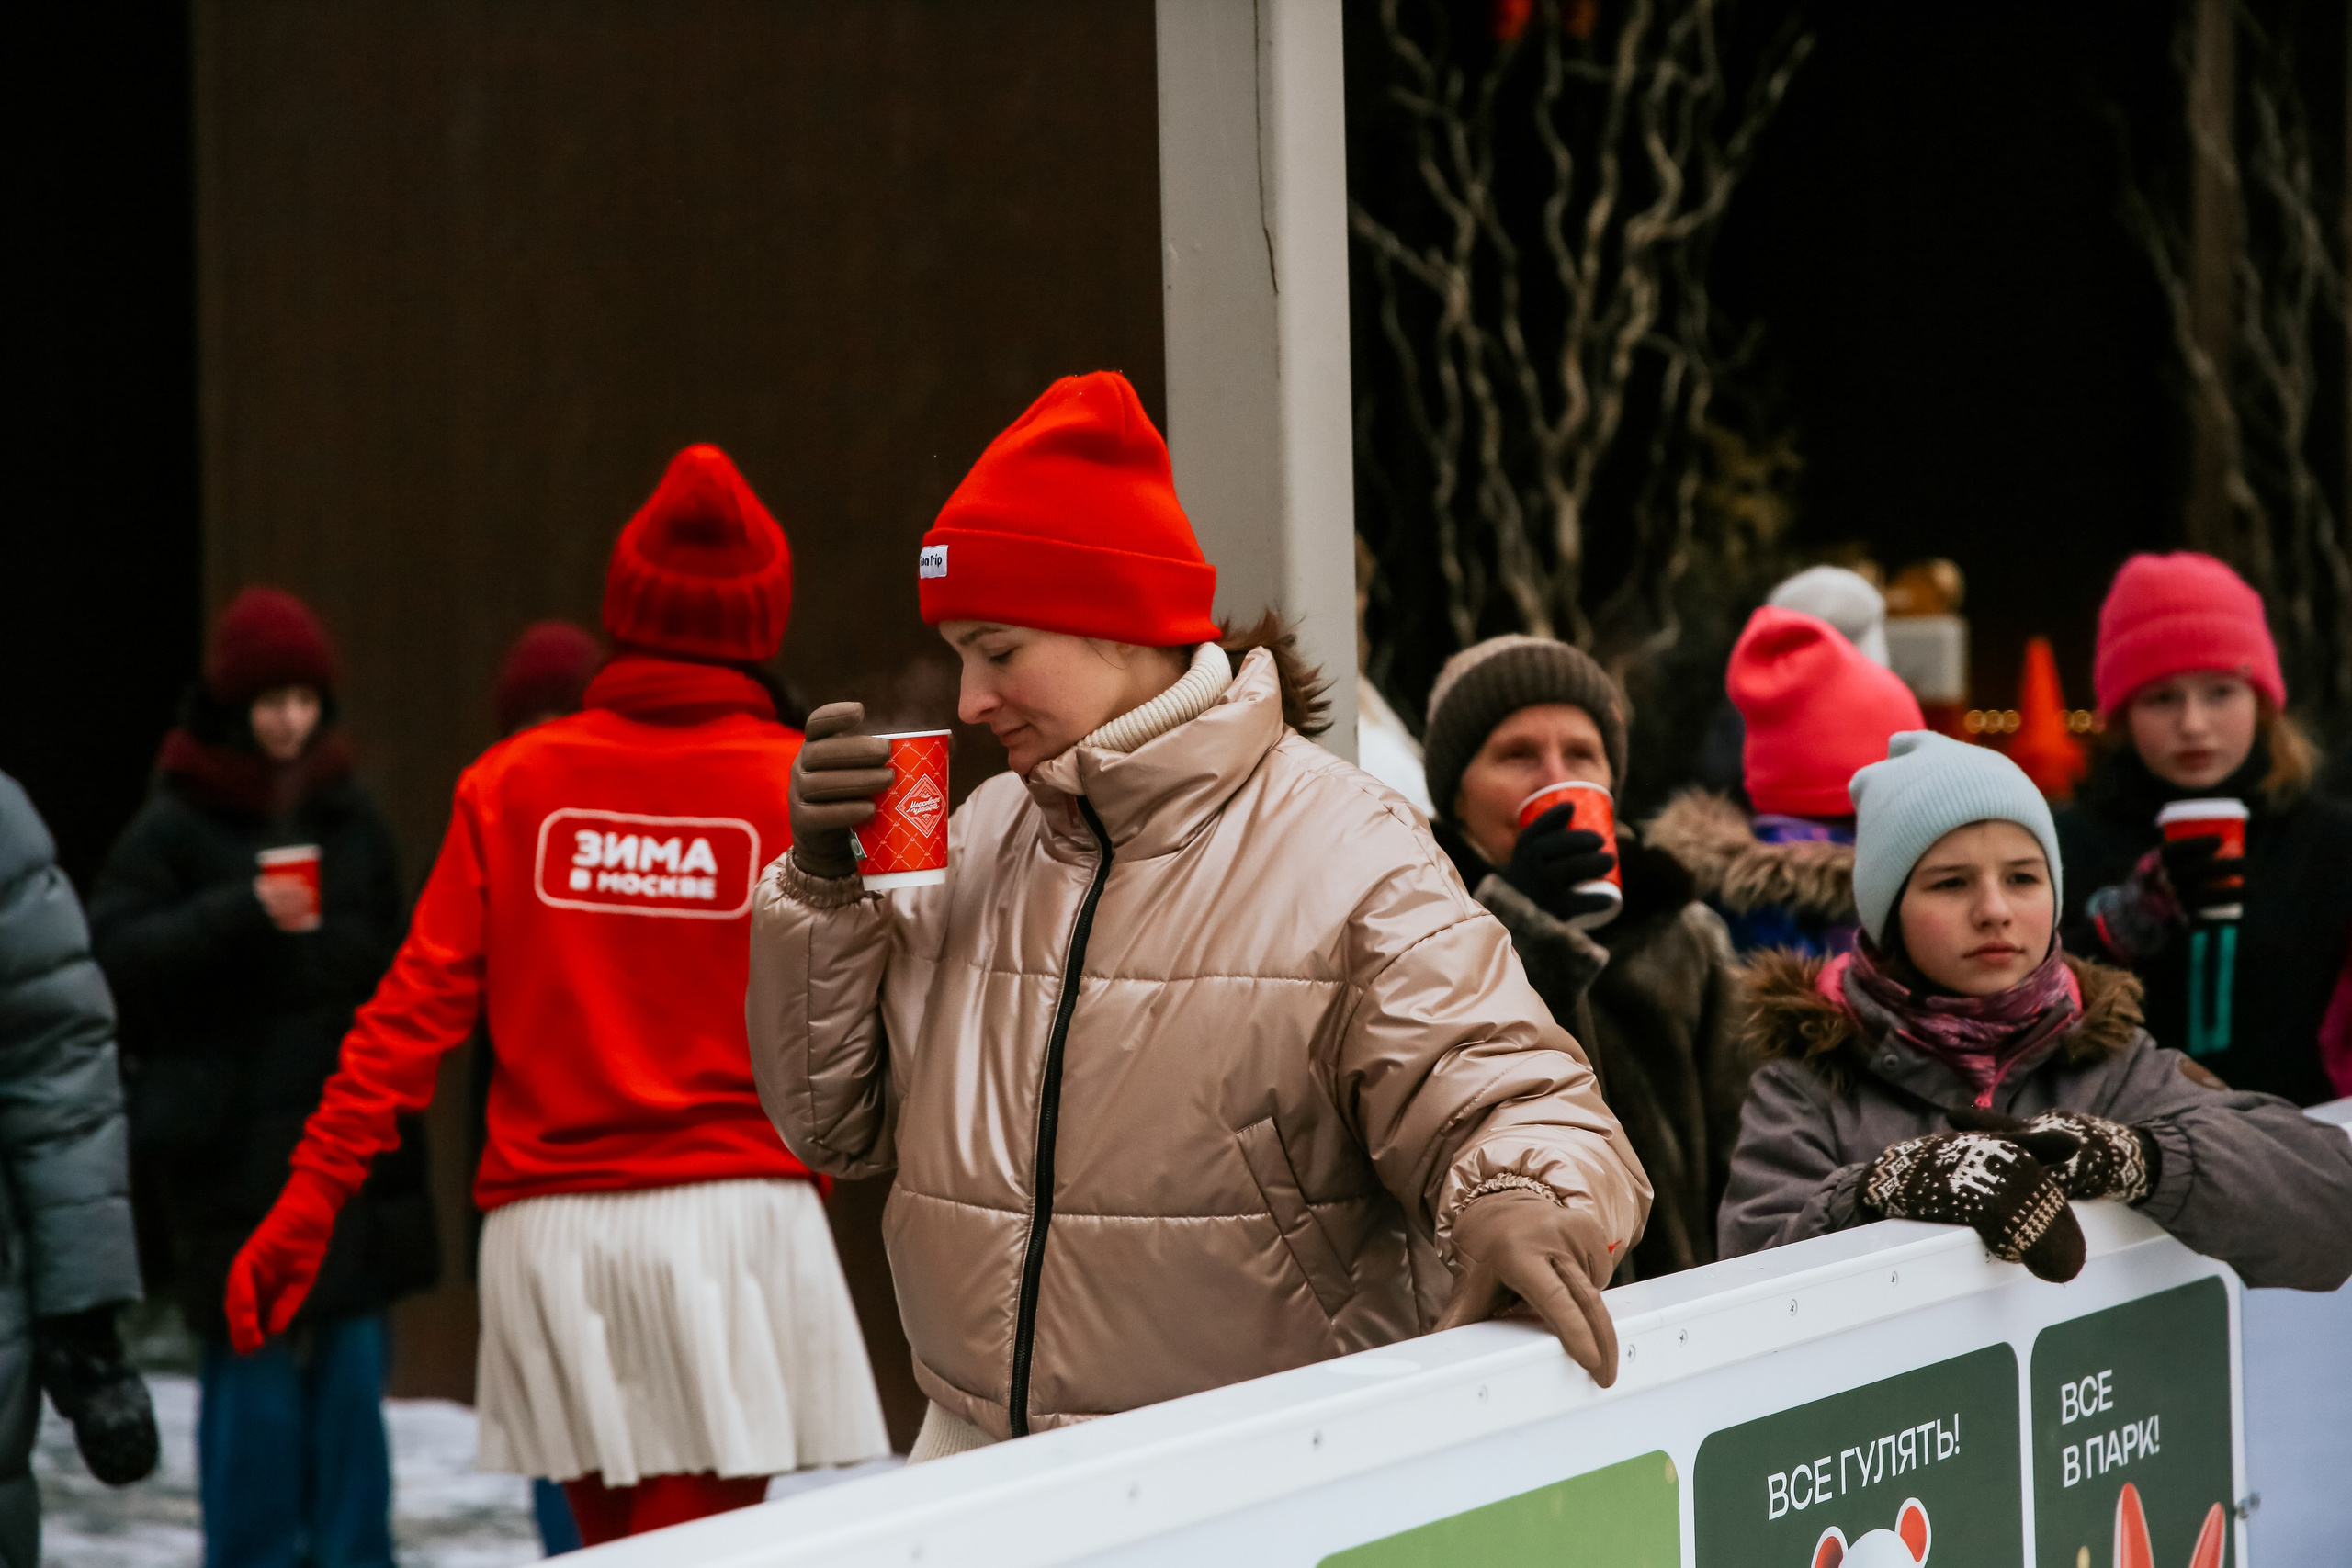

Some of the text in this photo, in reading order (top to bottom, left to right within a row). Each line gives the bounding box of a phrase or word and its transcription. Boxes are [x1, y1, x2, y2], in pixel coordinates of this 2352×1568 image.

[931, 554, 942, 567] Trip
[571, 829, 718, 874] ЗИМА
[597, 872, 716, 900] МОСКВЕ
[2061, 1369, 2113, 1425] ВСЕ
[1767, 1413, 1961, 1521] ВСЕ ГУЛЯТЬ!
[2063, 1415, 2161, 1488] В ПАРК!
